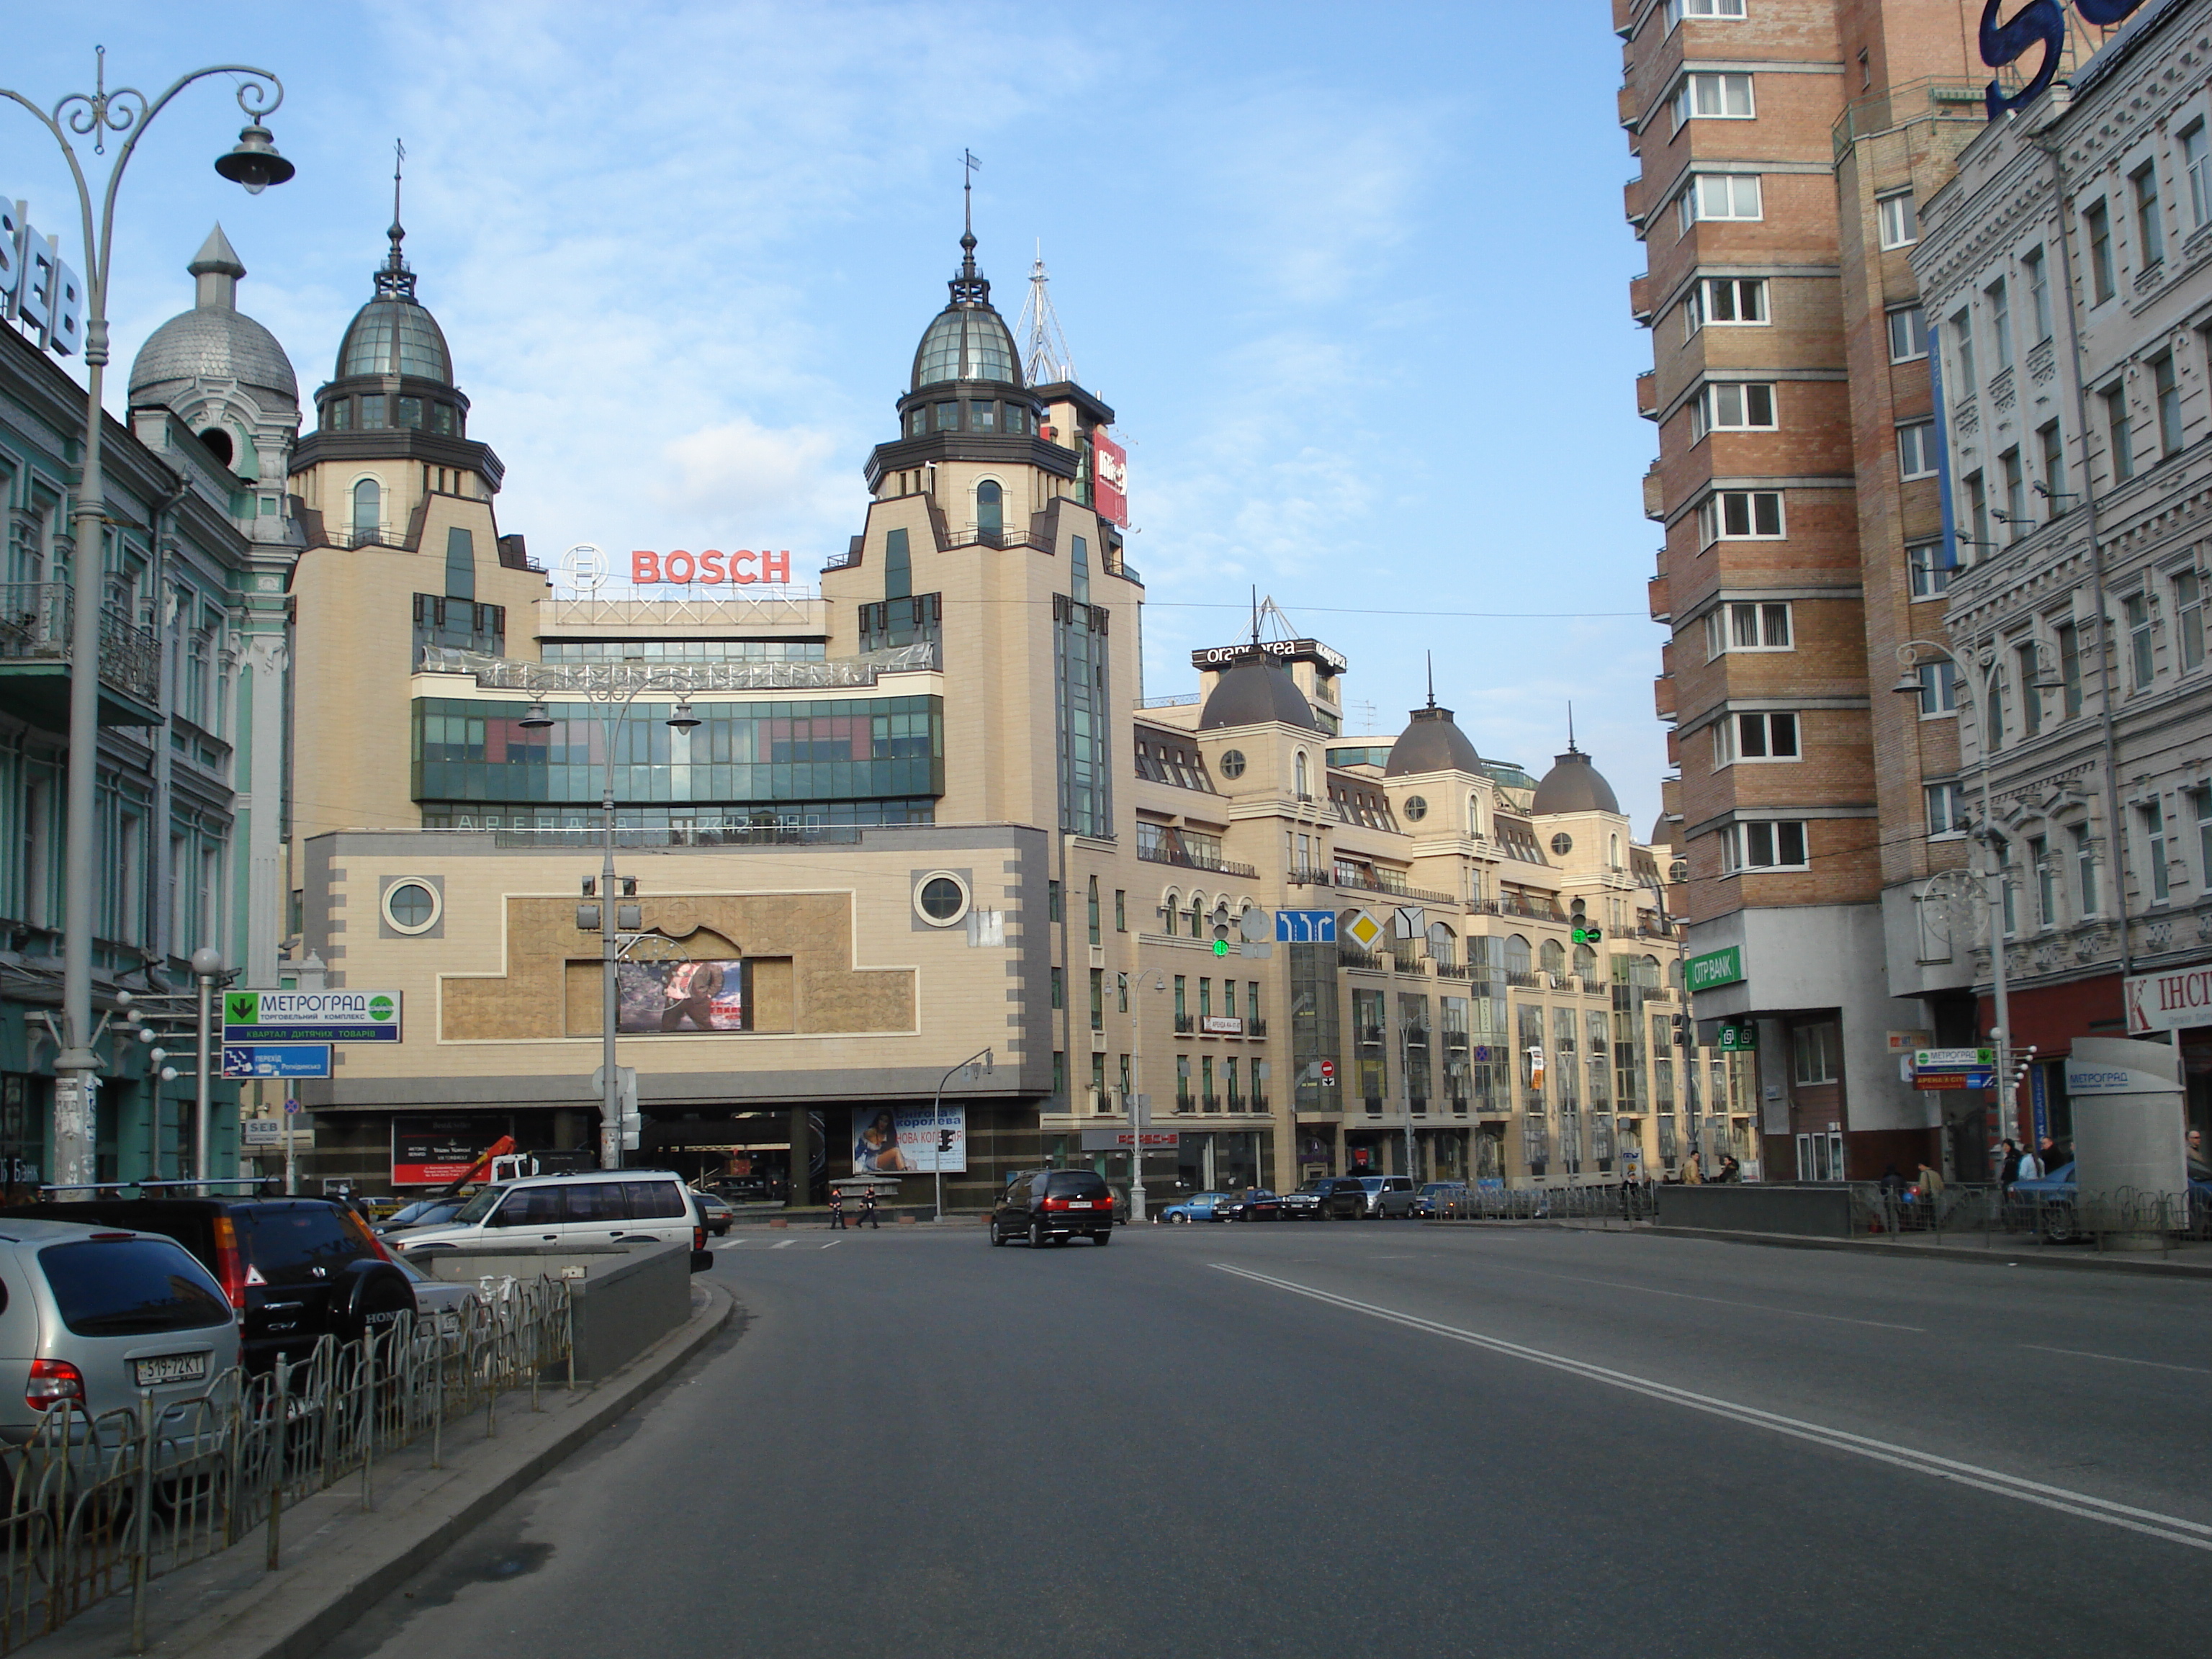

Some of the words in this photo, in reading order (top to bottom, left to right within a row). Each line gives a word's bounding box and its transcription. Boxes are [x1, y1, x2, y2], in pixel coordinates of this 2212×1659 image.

[0, 195, 82, 356] SEB
[632, 549, 790, 584] BOSCH
[457, 814, 629, 836] АРЕНДА
[1694, 961, 1709, 984] OTP
[1709, 955, 1732, 980] BANK
[2158, 971, 2212, 1011] ІНСІ
[261, 995, 366, 1012] МЕТРОГРАД
[1930, 1051, 1976, 1059] МЕТРОГРАД
[2070, 1072, 2128, 1083] МЕТРОГРАД
[251, 1123, 277, 1131] SEB
[896, 1117, 961, 1128] королева
[895, 1132, 918, 1144] НОВА
[921, 1130, 962, 1144] КОЛЕІЯ
[366, 1312, 400, 1323] HON
